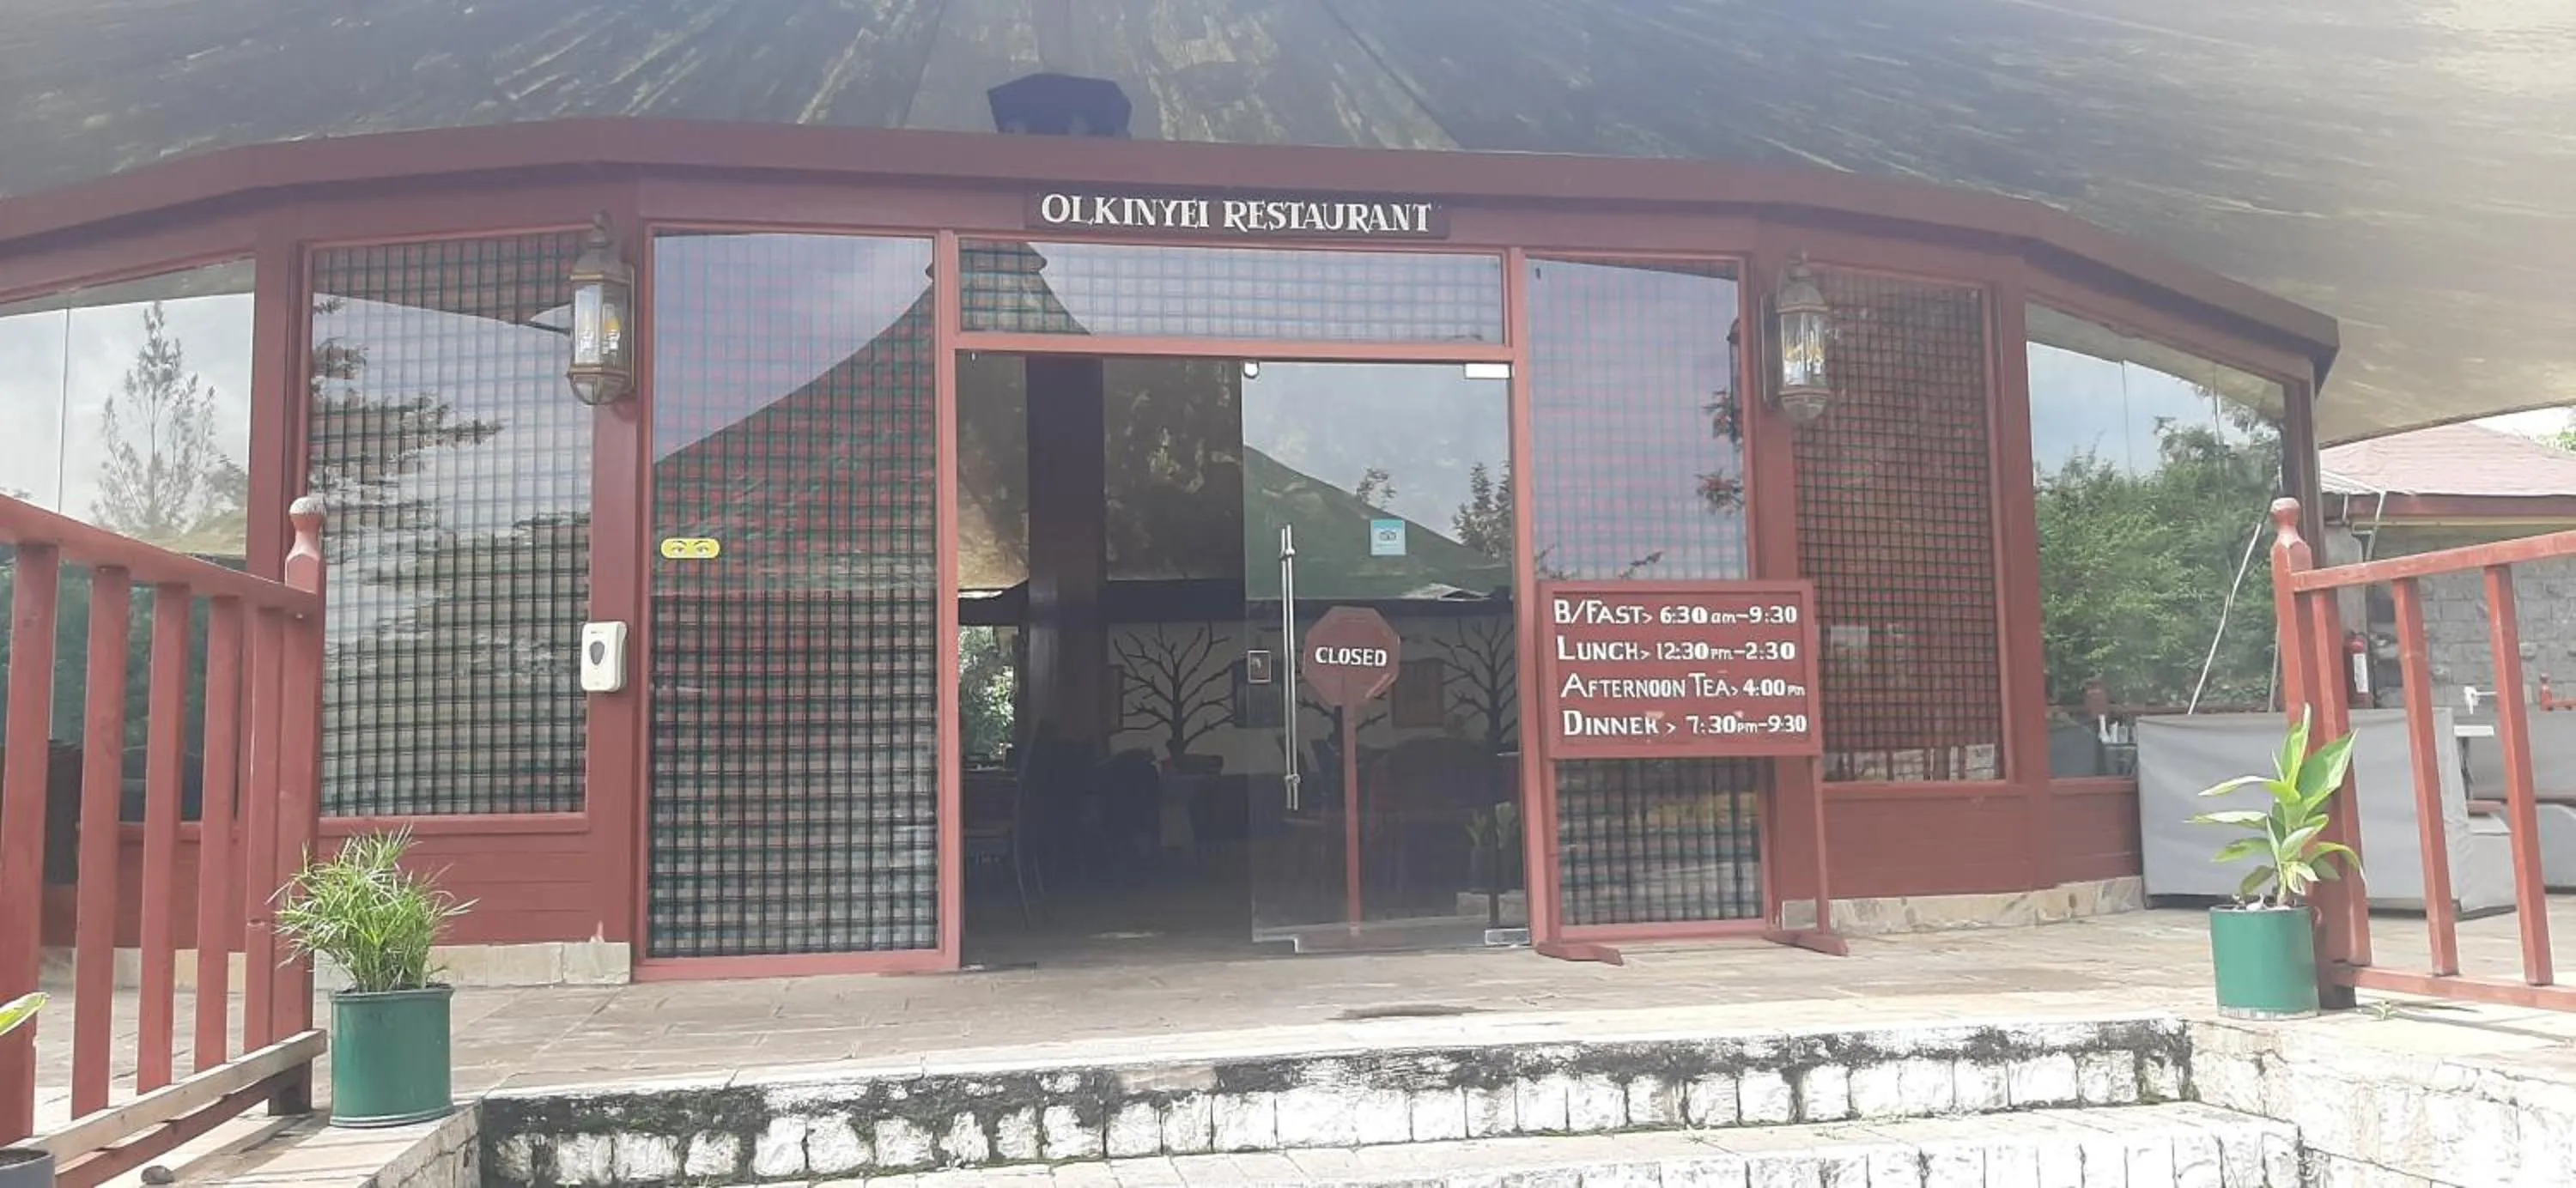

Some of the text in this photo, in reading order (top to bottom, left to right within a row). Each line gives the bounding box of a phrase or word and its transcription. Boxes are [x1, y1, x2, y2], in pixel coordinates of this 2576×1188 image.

[1041, 193, 1431, 233] OLKINYEI RESTAURANT
[1315, 646, 1388, 667] CLOSED
[1560, 673, 1686, 698] AFTERNOON
